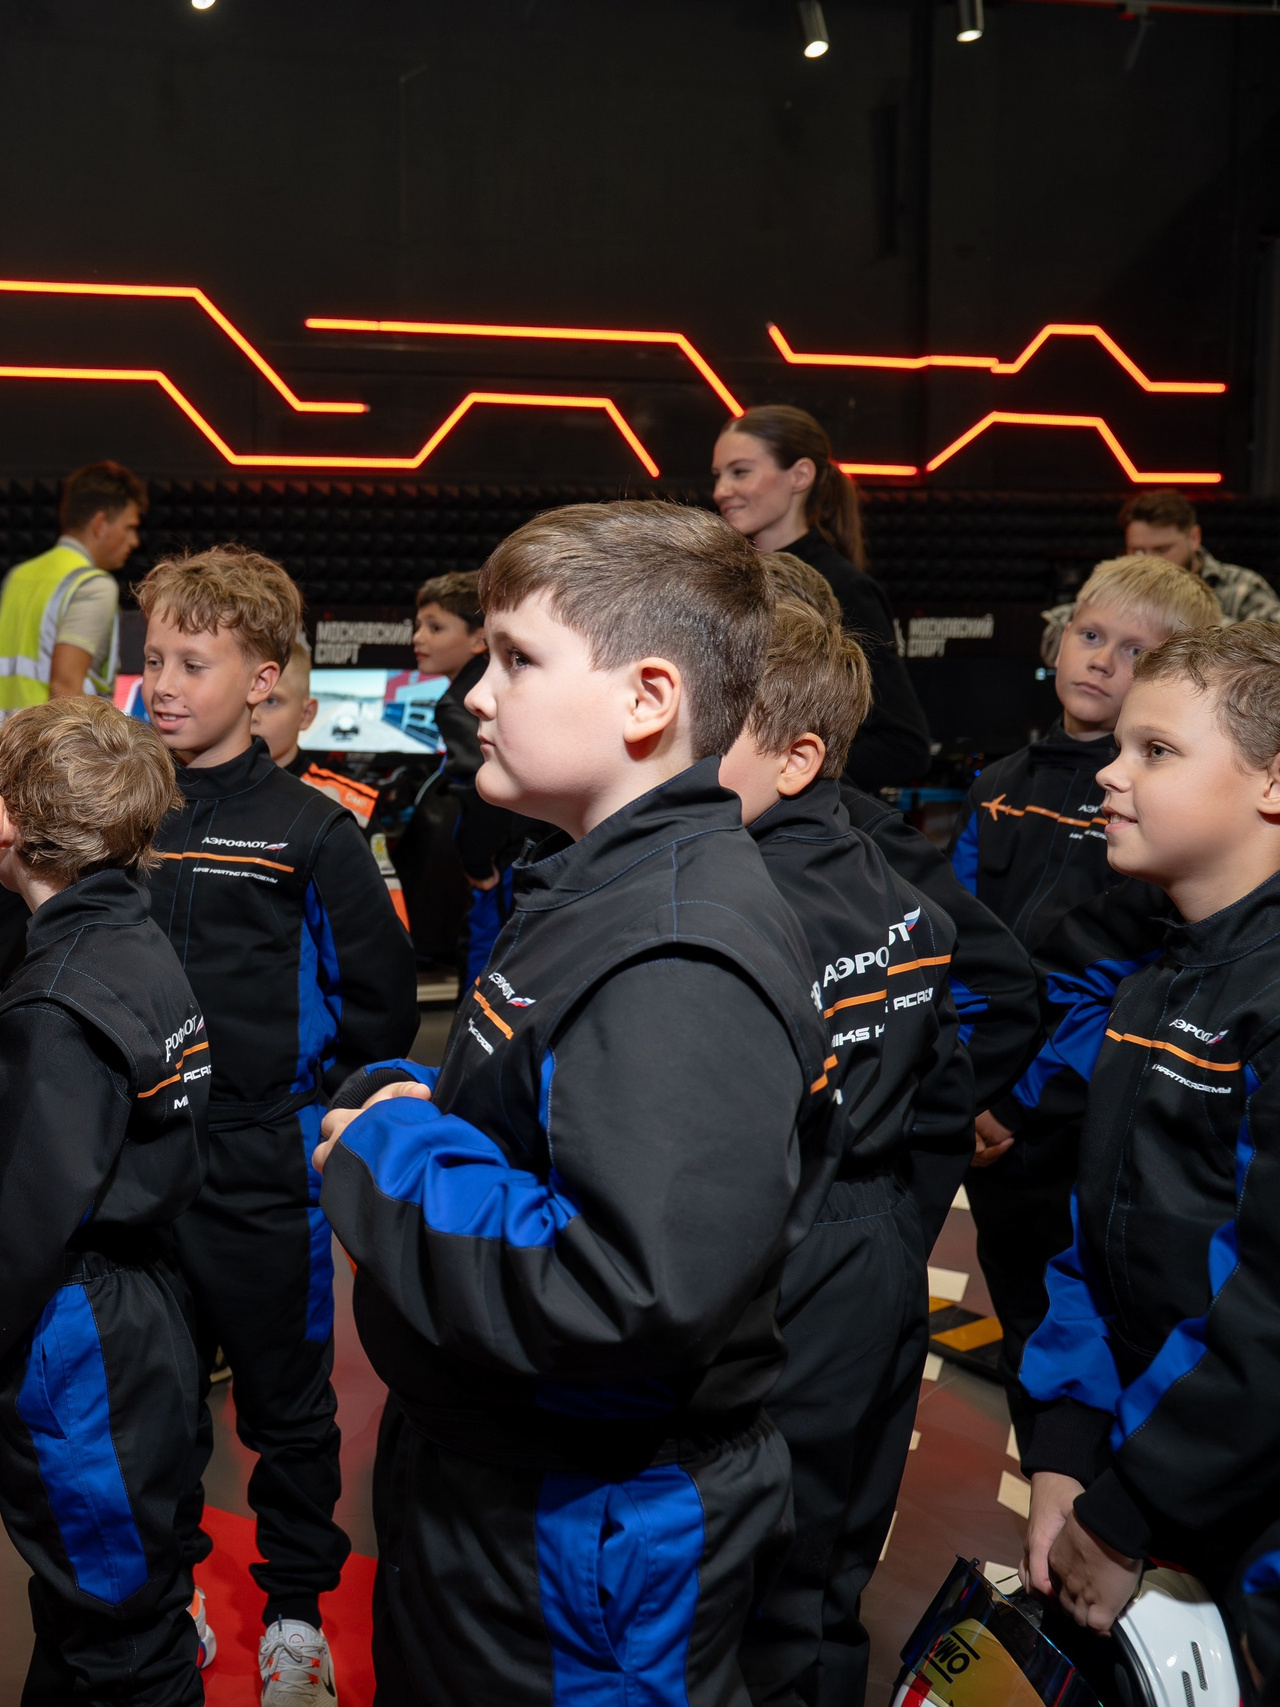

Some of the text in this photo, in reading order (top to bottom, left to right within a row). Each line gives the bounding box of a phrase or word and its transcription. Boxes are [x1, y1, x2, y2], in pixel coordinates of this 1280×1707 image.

[316, 618, 413, 645] МОСКОВСКИЙ
[908, 613, 994, 639] МОСКОВСКИЙ
[314, 642, 361, 664] СПОРТ
[907, 638, 947, 658] СПОРТ
[201, 836, 268, 850] АЭРОФЛОТ
[932, 1637, 970, 1674] OM
